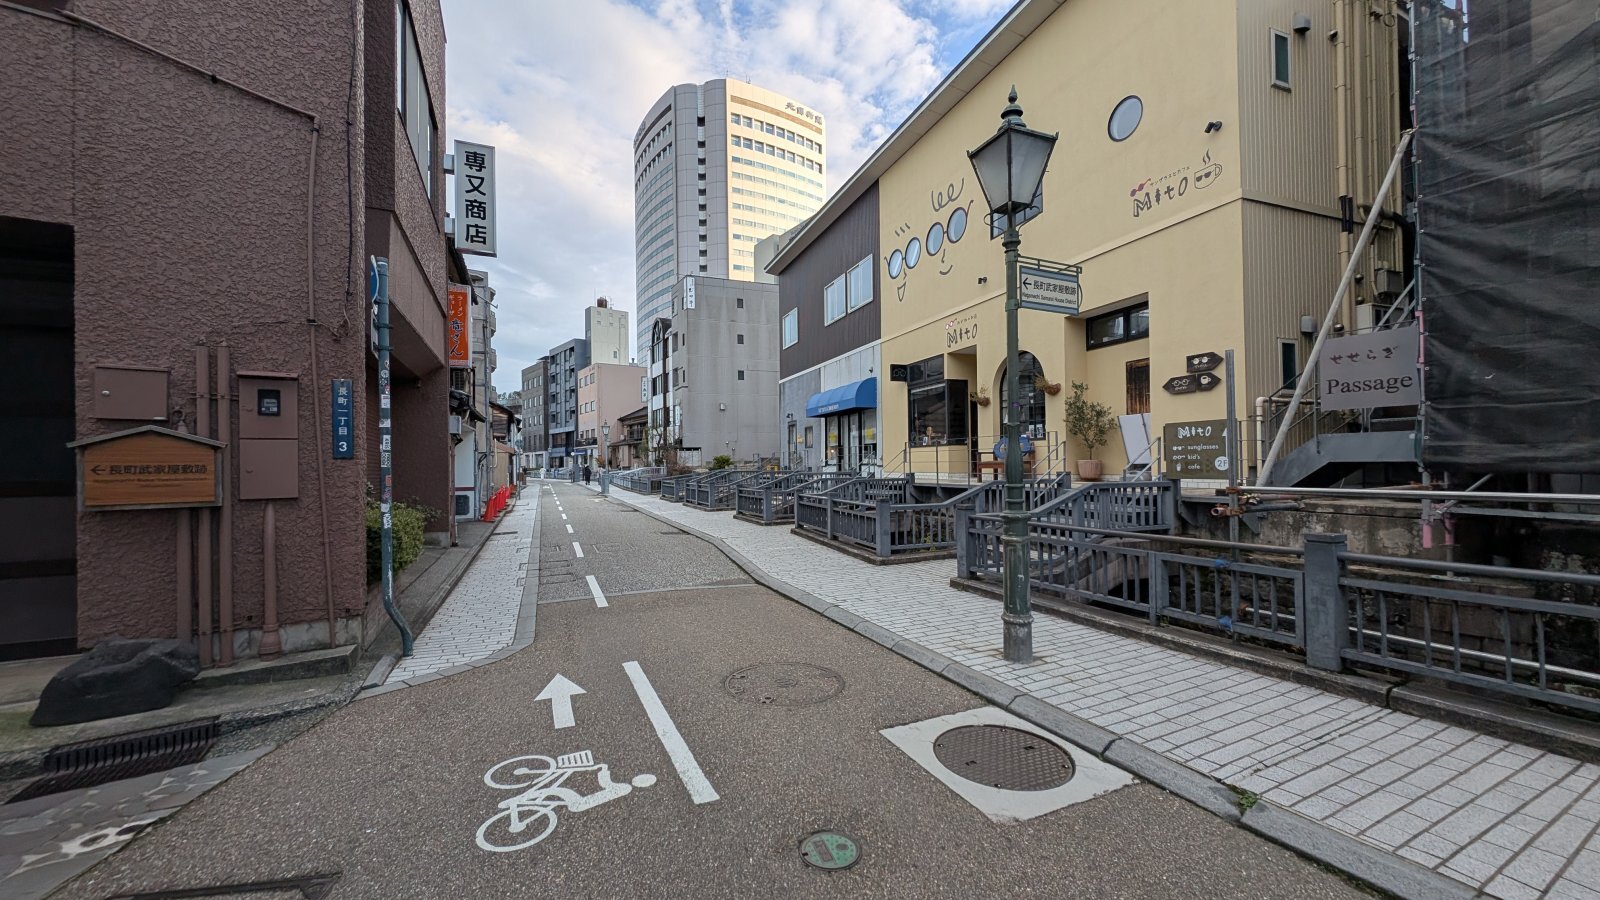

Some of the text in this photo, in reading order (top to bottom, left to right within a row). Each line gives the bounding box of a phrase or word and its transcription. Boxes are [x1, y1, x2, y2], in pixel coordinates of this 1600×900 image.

[464, 150, 487, 245] 専又商店
[1329, 346, 1399, 364] せせらぎ
[1326, 375, 1414, 395] Passage
[337, 386, 348, 452] 長町一丁目 3
[1187, 443, 1219, 452] sunglasses
